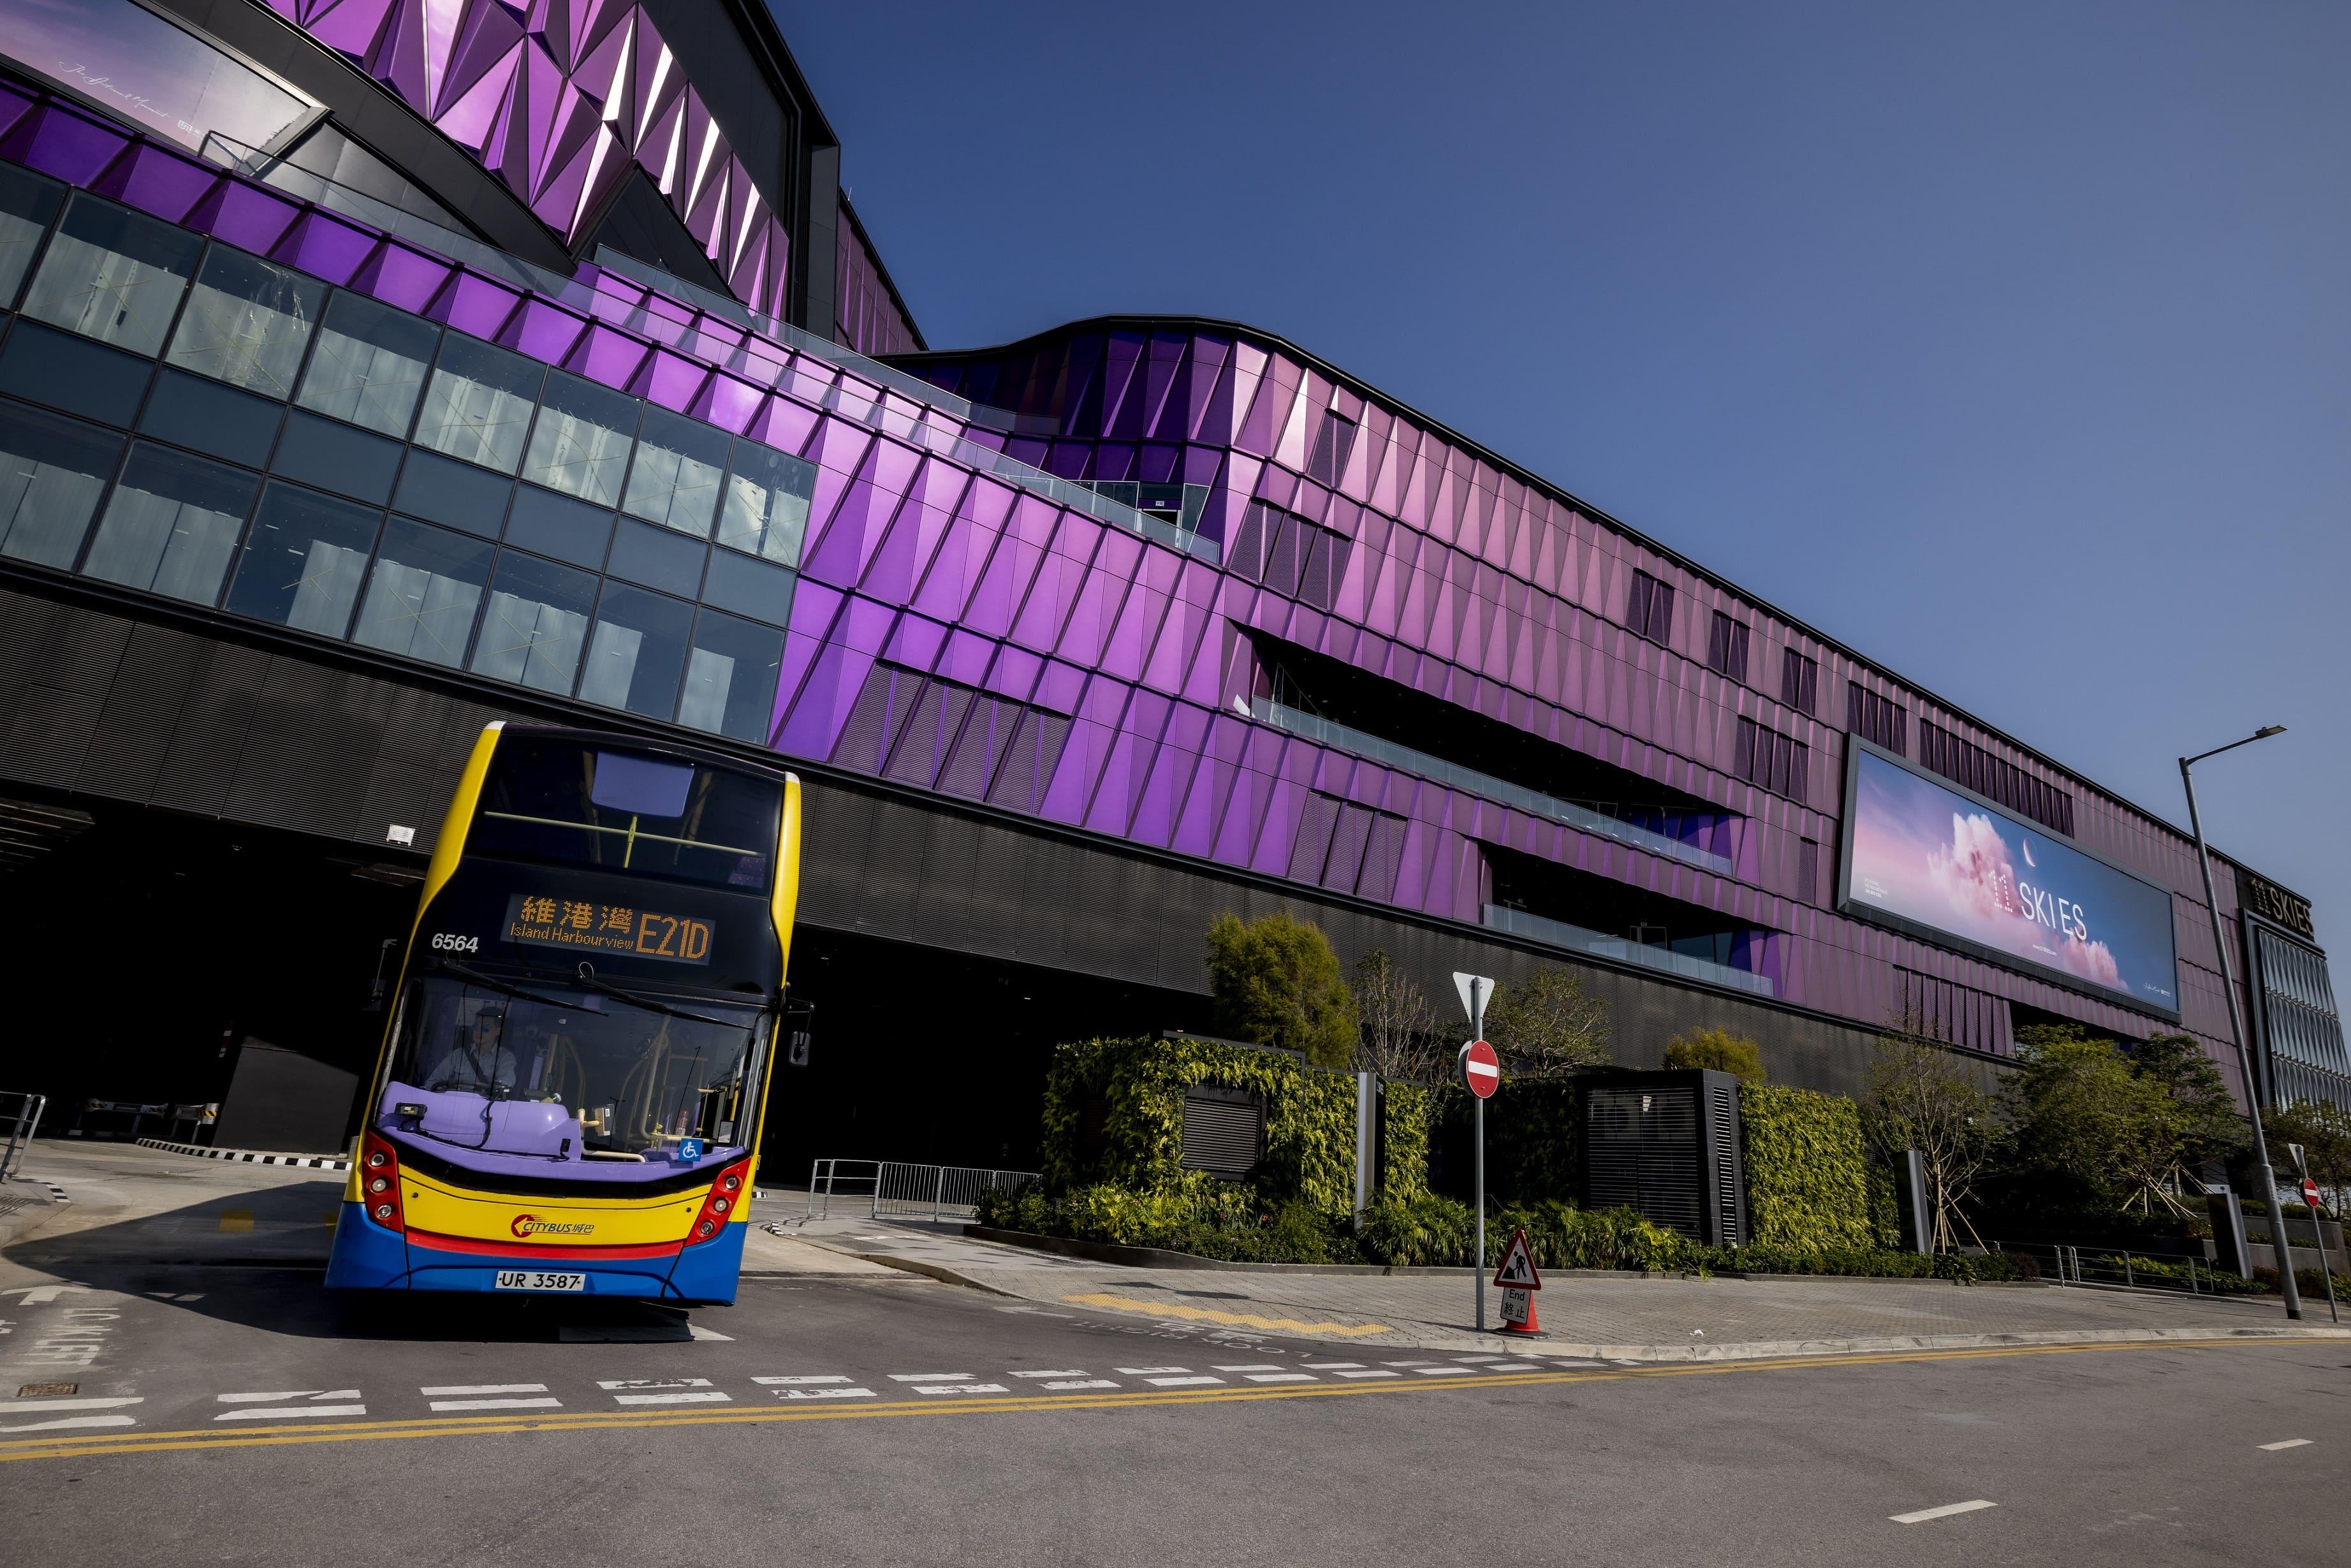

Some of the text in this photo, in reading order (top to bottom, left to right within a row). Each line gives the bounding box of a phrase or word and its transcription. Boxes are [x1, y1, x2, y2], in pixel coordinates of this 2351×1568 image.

[521, 896, 633, 934] 維港灣
[1988, 870, 2087, 941] 11 SKIES
[2269, 887, 2314, 936] SKIES
[432, 933, 479, 953] 6564
[510, 922, 633, 949] Island Harbourview
[636, 913, 709, 959] E21D
[523, 1222, 595, 1233] CITYBUS 城巴
[502, 1273, 580, 1289] UR 3587
[1509, 1289, 1525, 1301] End
[1504, 1302, 1525, 1319] 終止
